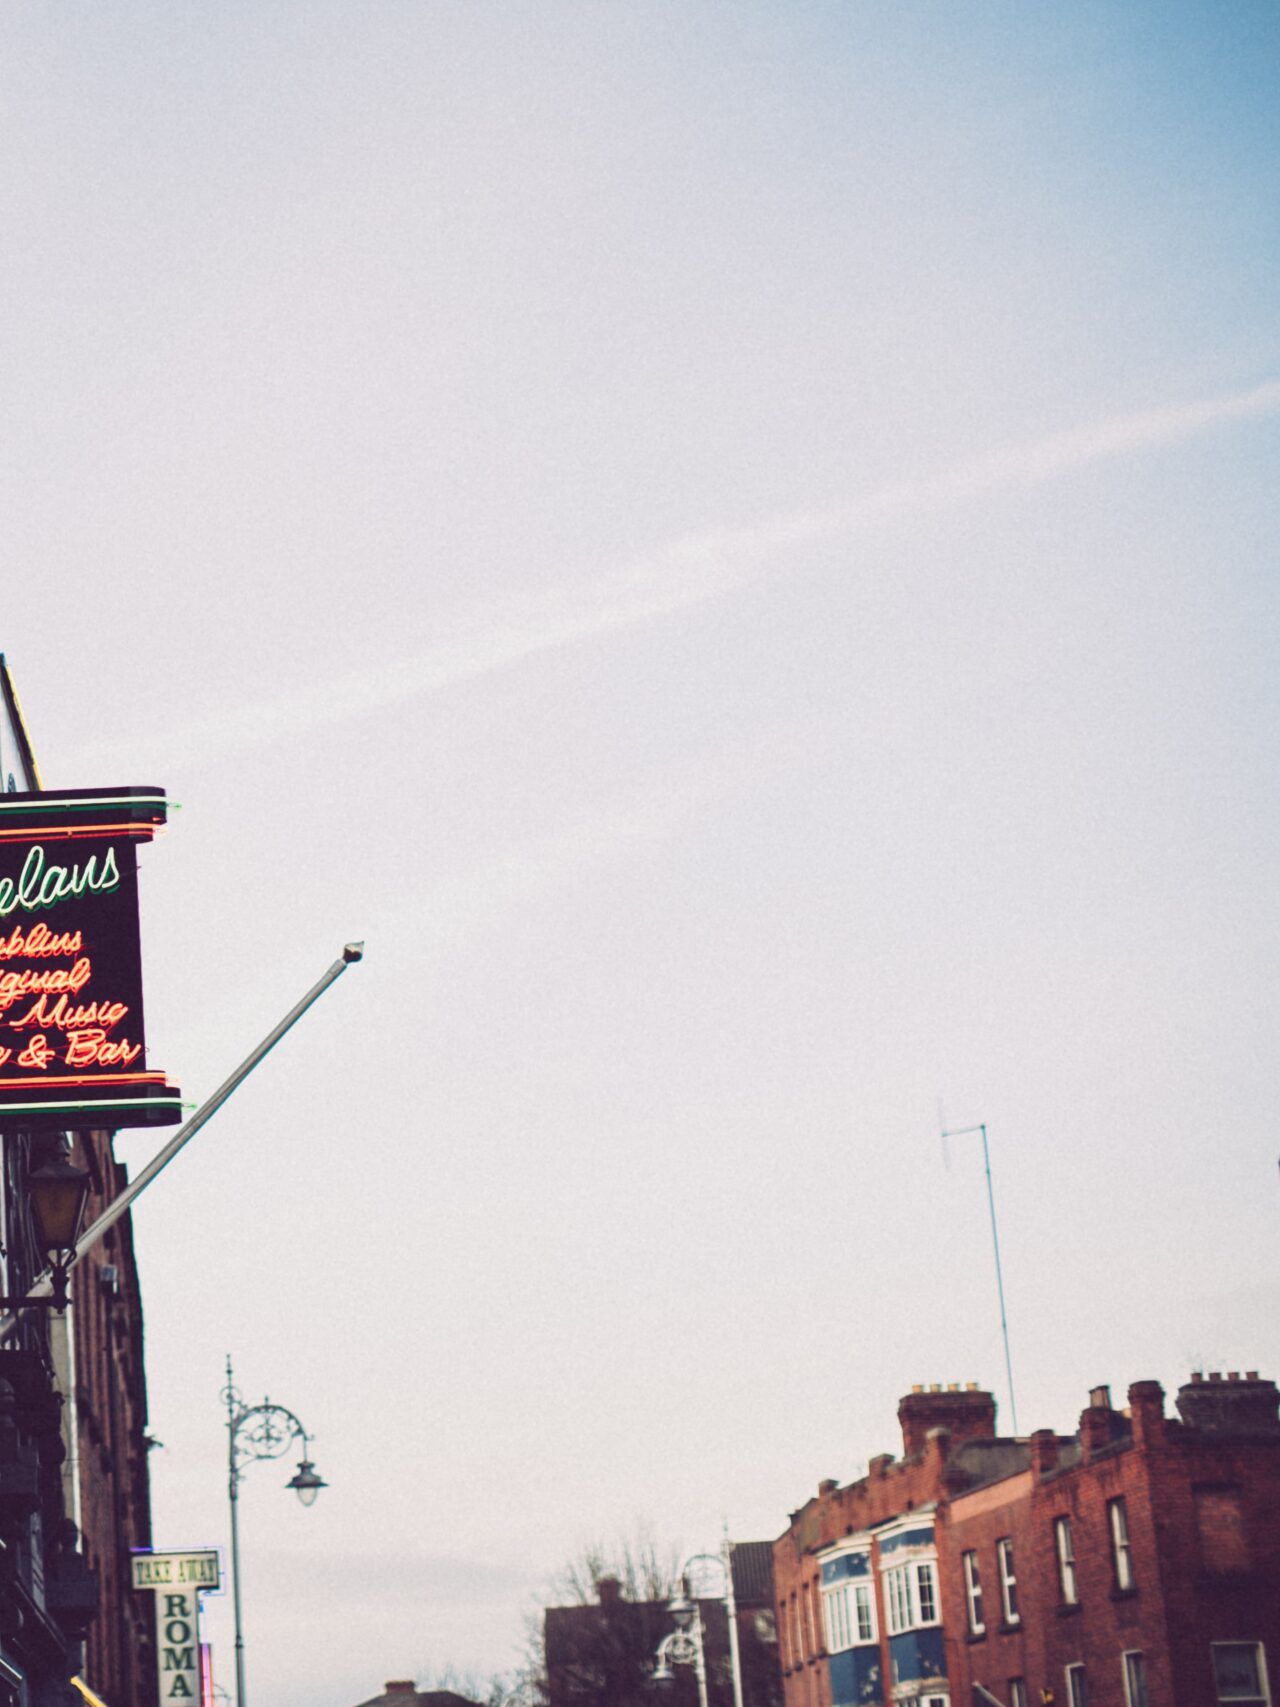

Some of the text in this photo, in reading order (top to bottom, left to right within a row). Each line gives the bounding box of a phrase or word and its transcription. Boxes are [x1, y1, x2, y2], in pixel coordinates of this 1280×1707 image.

[9, 994, 128, 1029] Music
[17, 1034, 56, 1069] &
[65, 1028, 142, 1067] Bar
[136, 1558, 216, 1585] TAKE AWAY
[163, 1594, 196, 1698] ROMA
